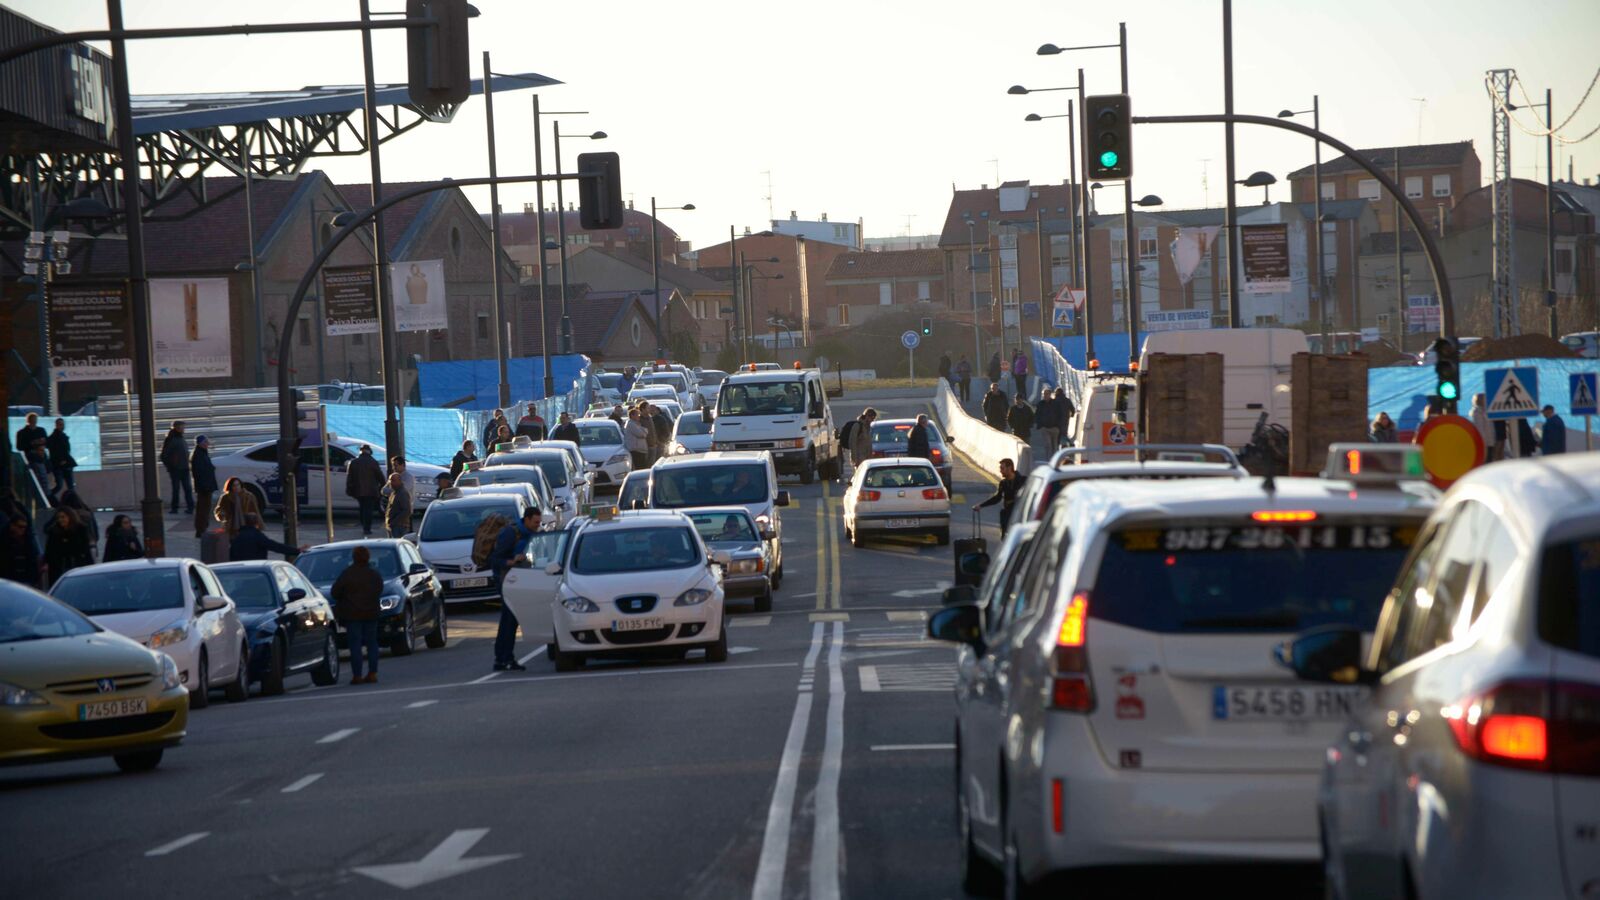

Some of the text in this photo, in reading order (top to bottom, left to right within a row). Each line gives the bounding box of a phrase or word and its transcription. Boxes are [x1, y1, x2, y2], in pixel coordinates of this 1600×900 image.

[326, 316, 378, 326] CaixaForum
[1168, 312, 1176, 321] DE
[51, 355, 129, 367] CaixaForum
[1350, 526, 1391, 548] 15
[618, 617, 661, 629] 0135 FYC
[1232, 691, 1305, 715] 5458
[87, 699, 144, 720] 7450 BSK
